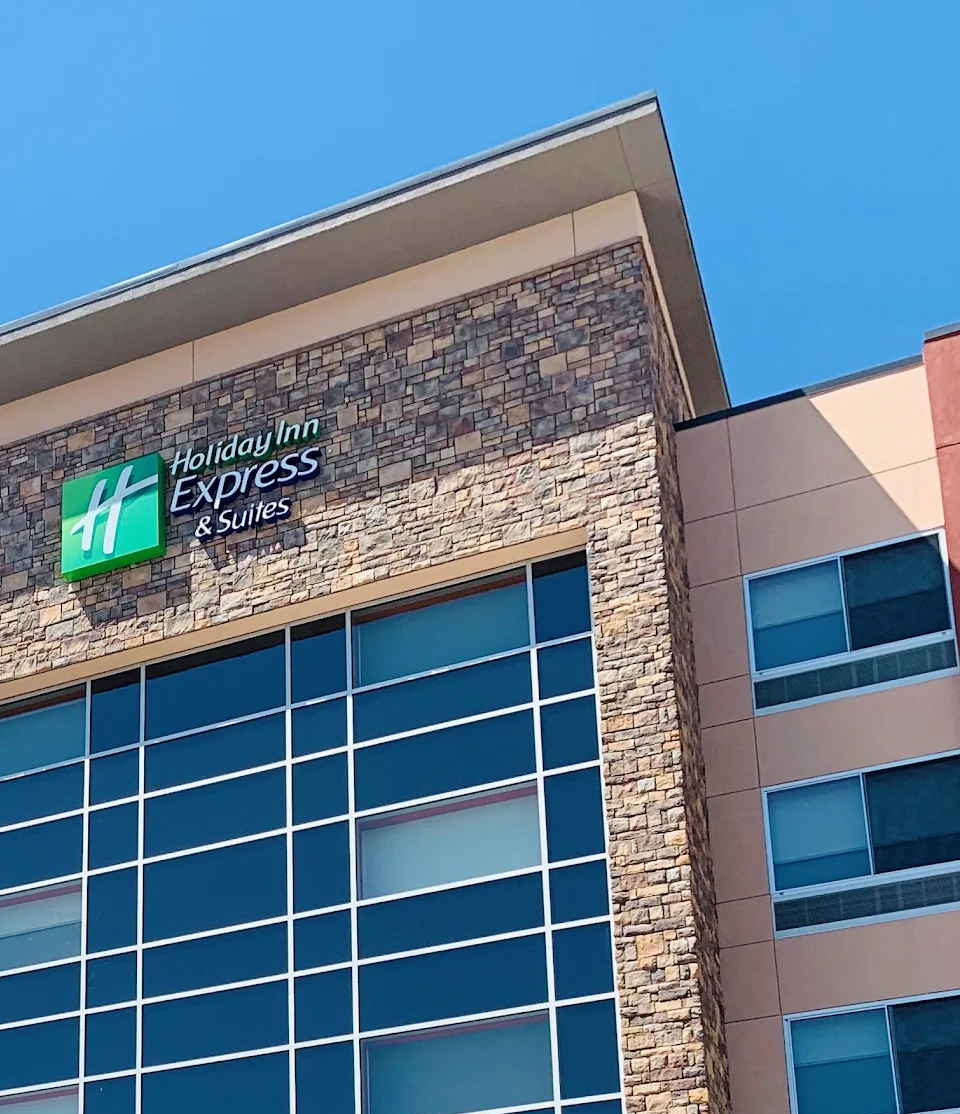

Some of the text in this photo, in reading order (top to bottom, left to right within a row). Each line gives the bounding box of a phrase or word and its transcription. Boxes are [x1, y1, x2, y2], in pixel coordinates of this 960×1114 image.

[170, 418, 320, 474] Holiday Inn
[170, 447, 321, 513] Express
[195, 498, 290, 538] & Suites
